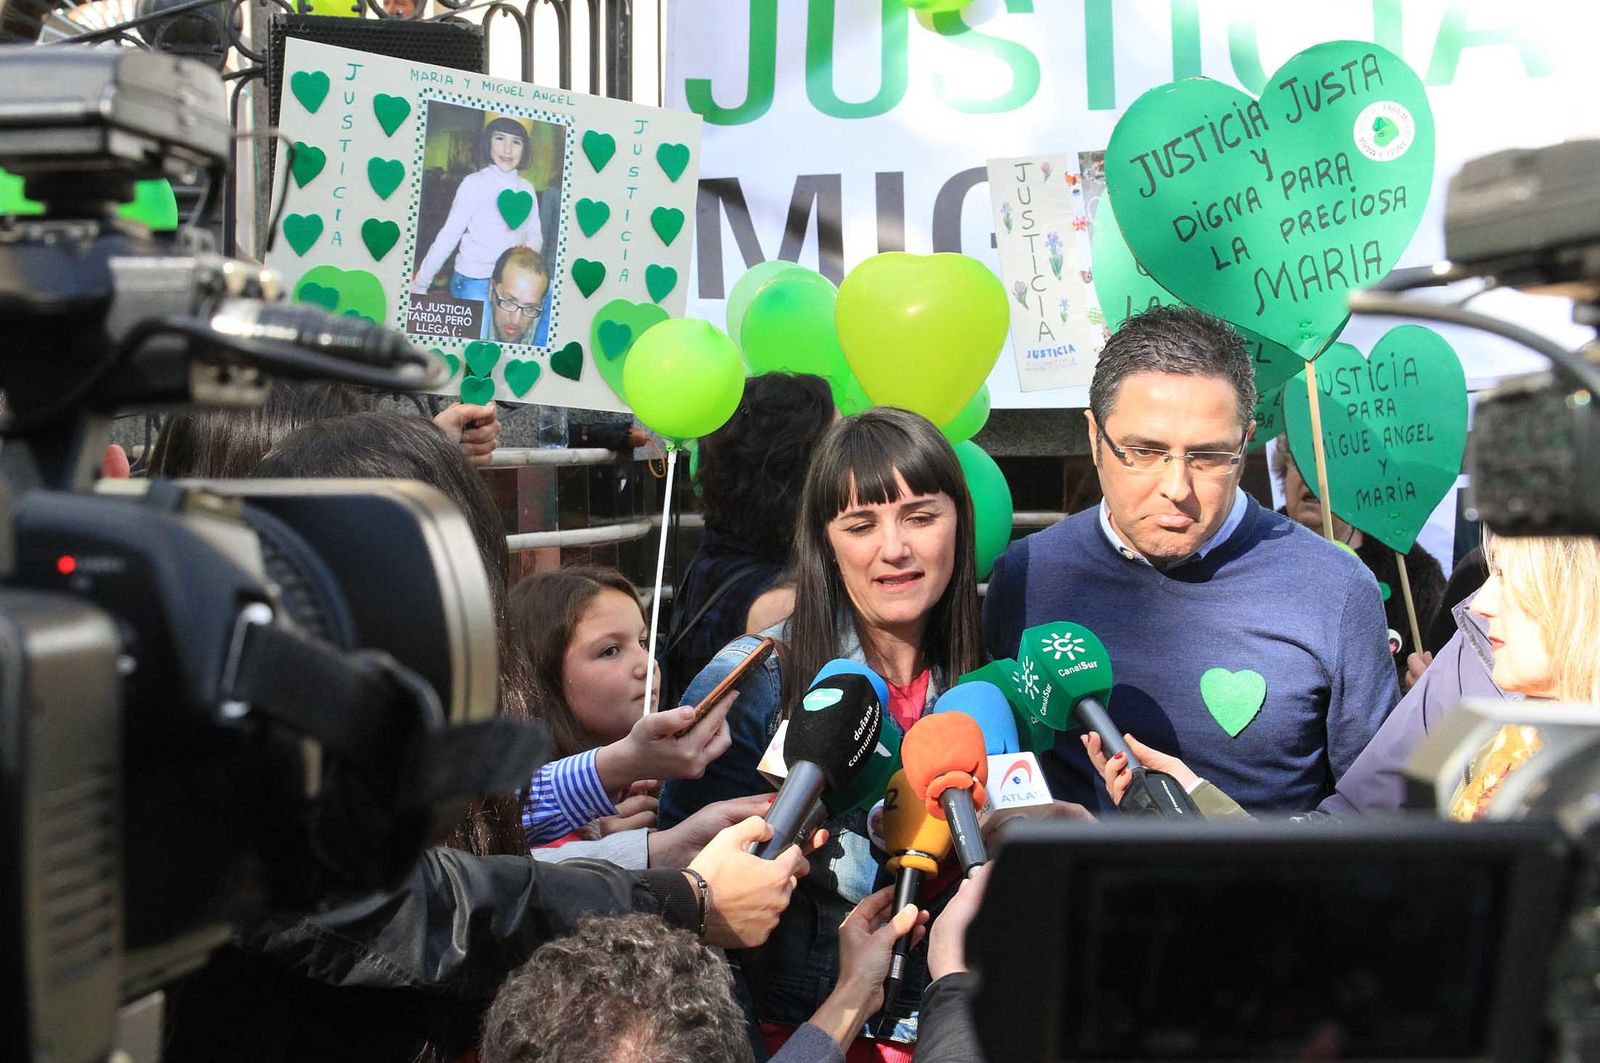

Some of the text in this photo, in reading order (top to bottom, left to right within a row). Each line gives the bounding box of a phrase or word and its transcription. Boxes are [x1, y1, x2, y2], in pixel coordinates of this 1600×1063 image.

[410, 68, 576, 106] MARIA Y MIGUEL ANGEL
[1279, 53, 1385, 124] JUSTA
[330, 62, 365, 247] JUSTICIA
[1280, 152, 1354, 201] PARA
[618, 119, 650, 283] JUSTICIA
[1014, 162, 1055, 343] JUSTICIA
[1211, 236, 1252, 271] LA
[1255, 239, 1384, 317] MARIA
[408, 311, 472, 326] TARDA PERO
[409, 301, 472, 316] LA JUSTICIA
[416, 322, 450, 335] LLEGA
[1026, 343, 1076, 359] JUSTICIA
[1306, 352, 1419, 398] USTICIA
[1346, 398, 1397, 422] PARA
[1383, 423, 1435, 449] ANGEL
[1378, 458, 1388, 475] Y
[1058, 660, 1098, 677] CanalSur
[1040, 683, 1052, 716] CanalSur
[853, 705, 874, 741] doñana
